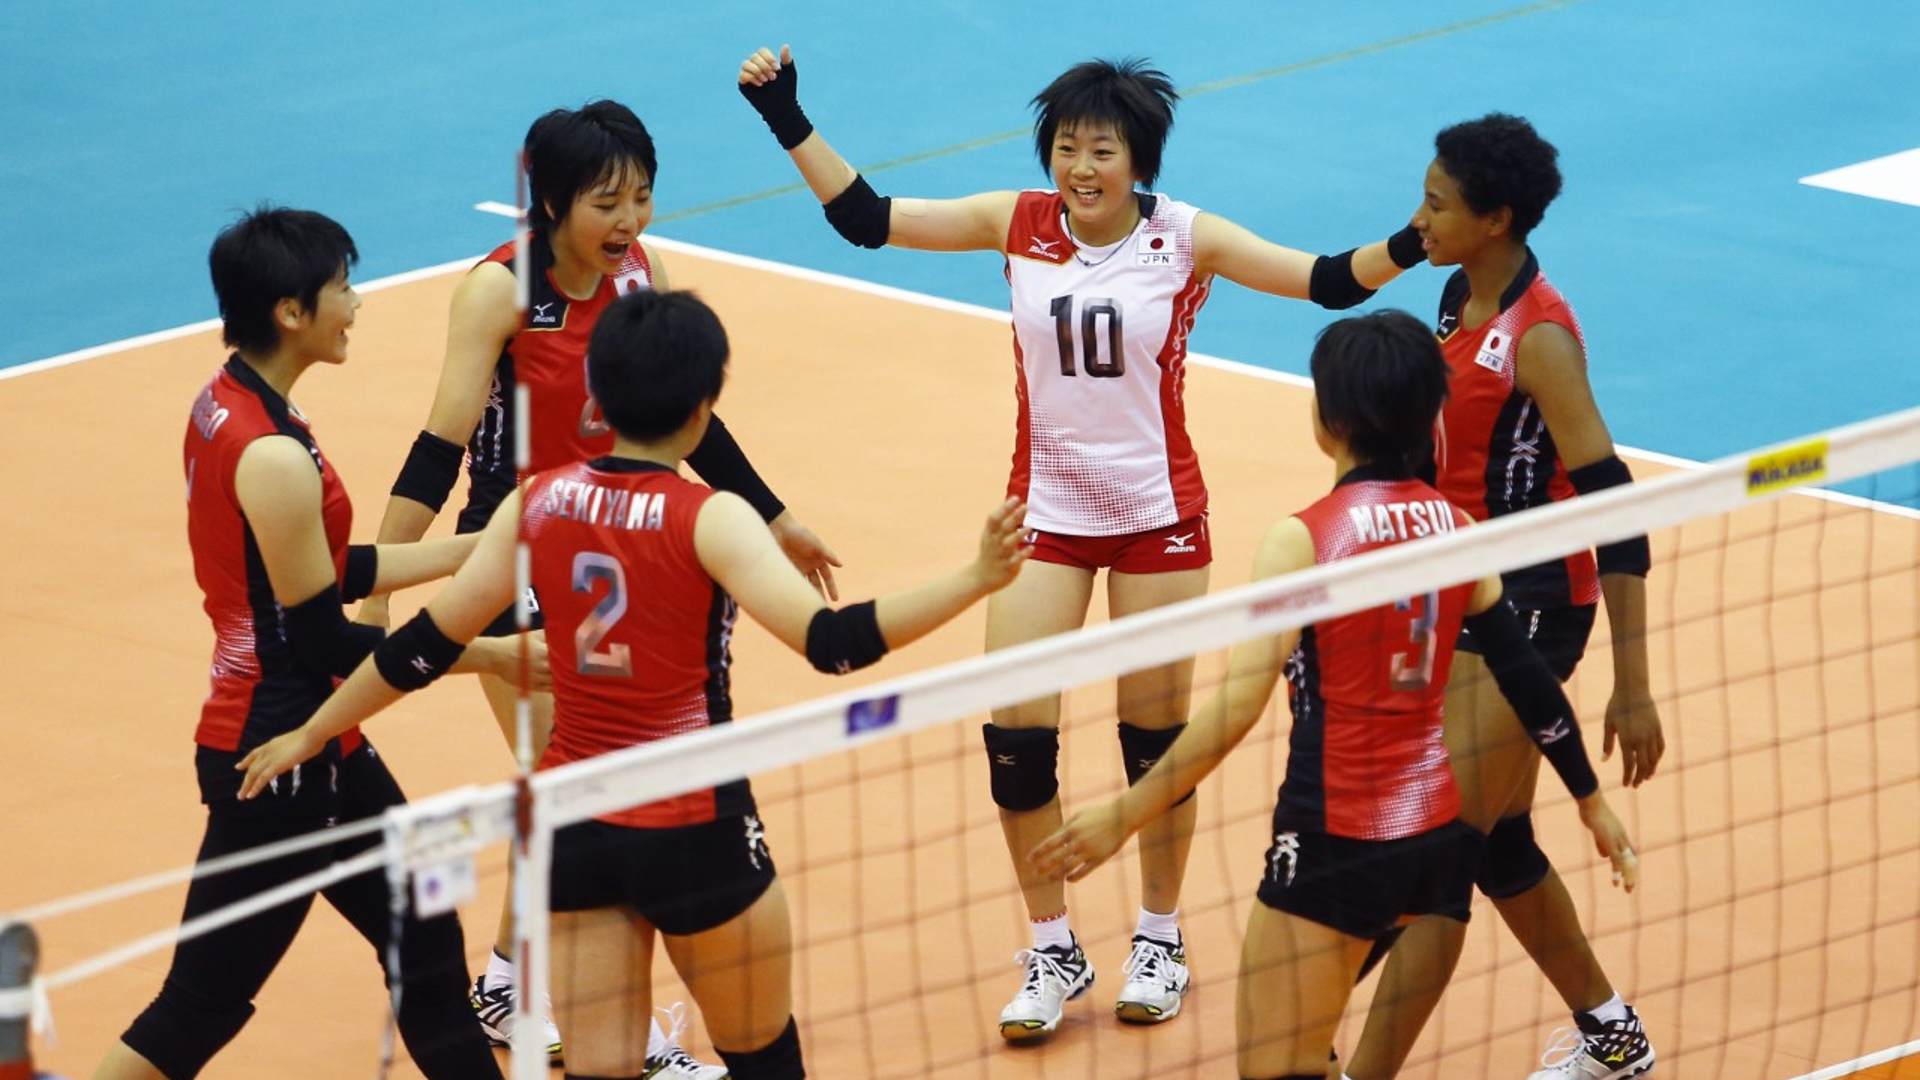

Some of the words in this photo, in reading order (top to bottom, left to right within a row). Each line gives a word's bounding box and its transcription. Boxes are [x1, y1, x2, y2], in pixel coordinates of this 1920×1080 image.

[1142, 255, 1170, 264] JPN
[1050, 294, 1126, 378] 10
[1350, 499, 1457, 544] MATSUI
[571, 550, 633, 678] 2
[1390, 586, 1440, 692] 3
